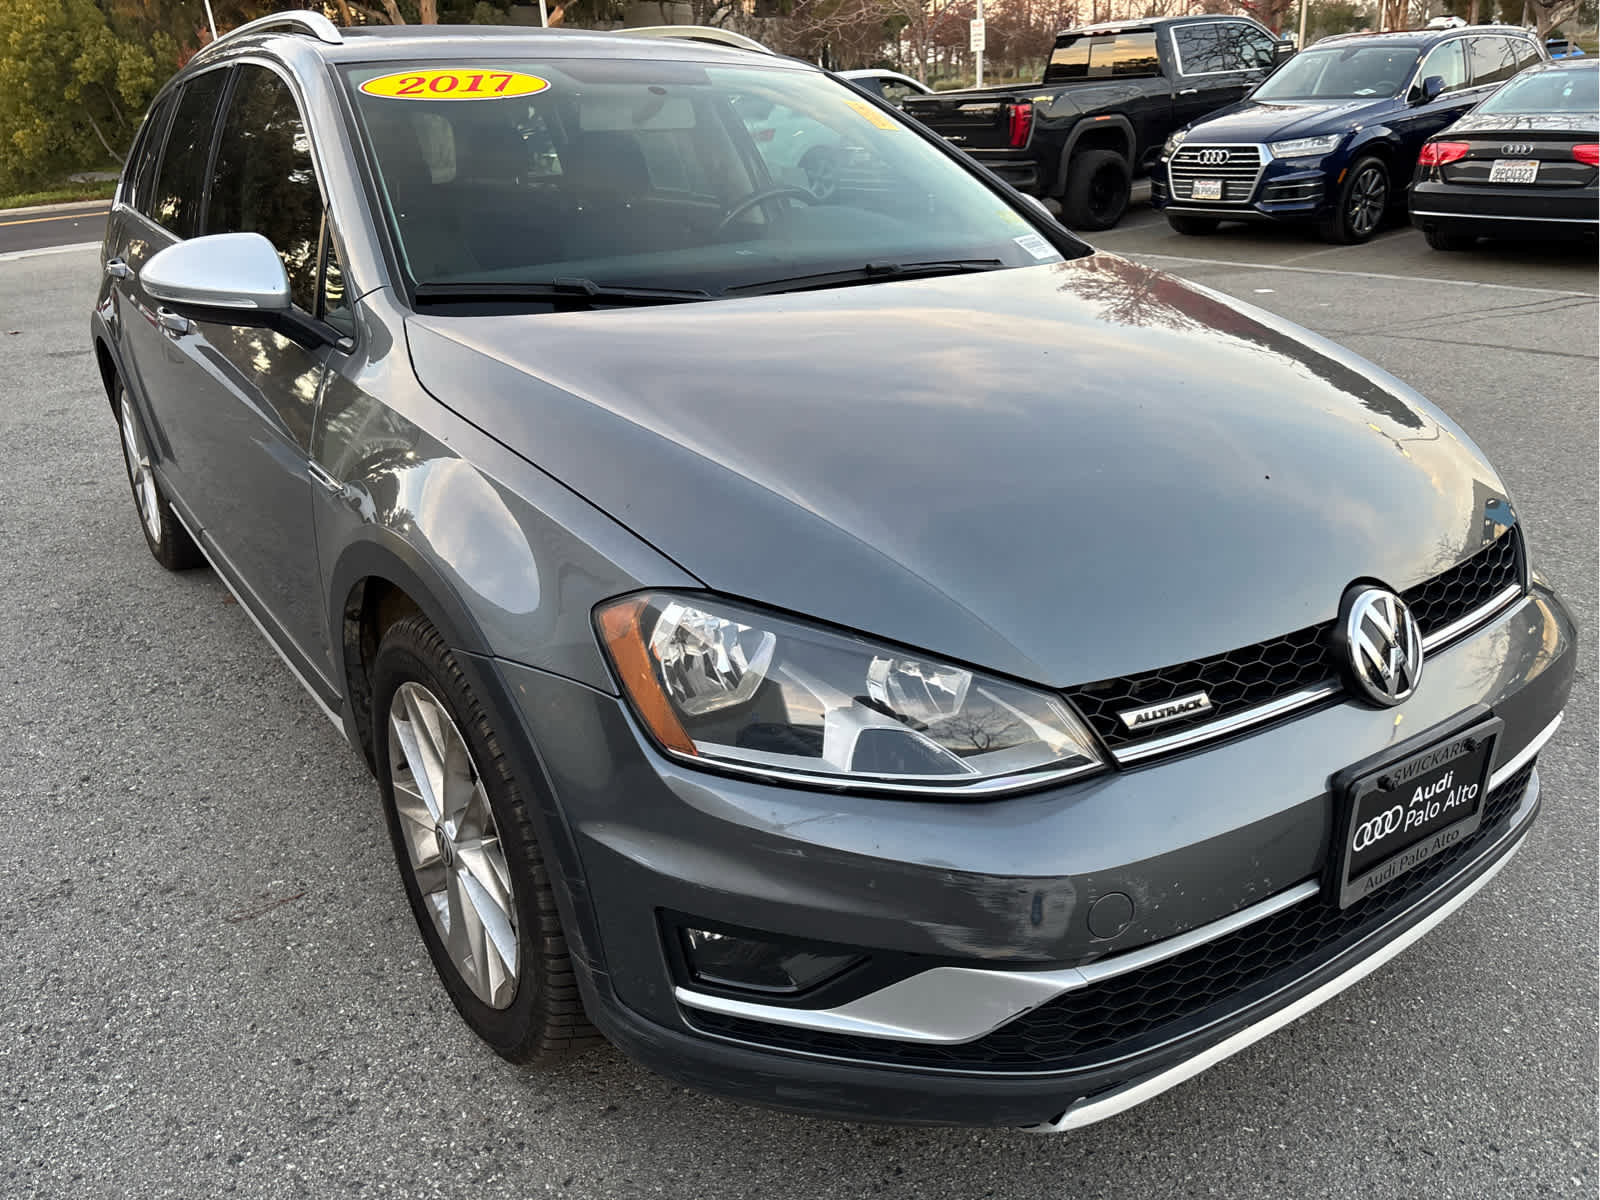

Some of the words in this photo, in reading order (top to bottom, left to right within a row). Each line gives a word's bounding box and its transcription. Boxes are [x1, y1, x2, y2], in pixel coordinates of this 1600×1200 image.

[396, 74, 513, 96] 2017
[1134, 698, 1203, 725] ALLTRACK
[1409, 771, 1454, 807] Audi
[1403, 800, 1440, 833] Palo
[1443, 783, 1479, 812] Alto
[1363, 863, 1396, 891] Audi
[1400, 847, 1429, 871] Palo
[1432, 829, 1460, 850] Alto
